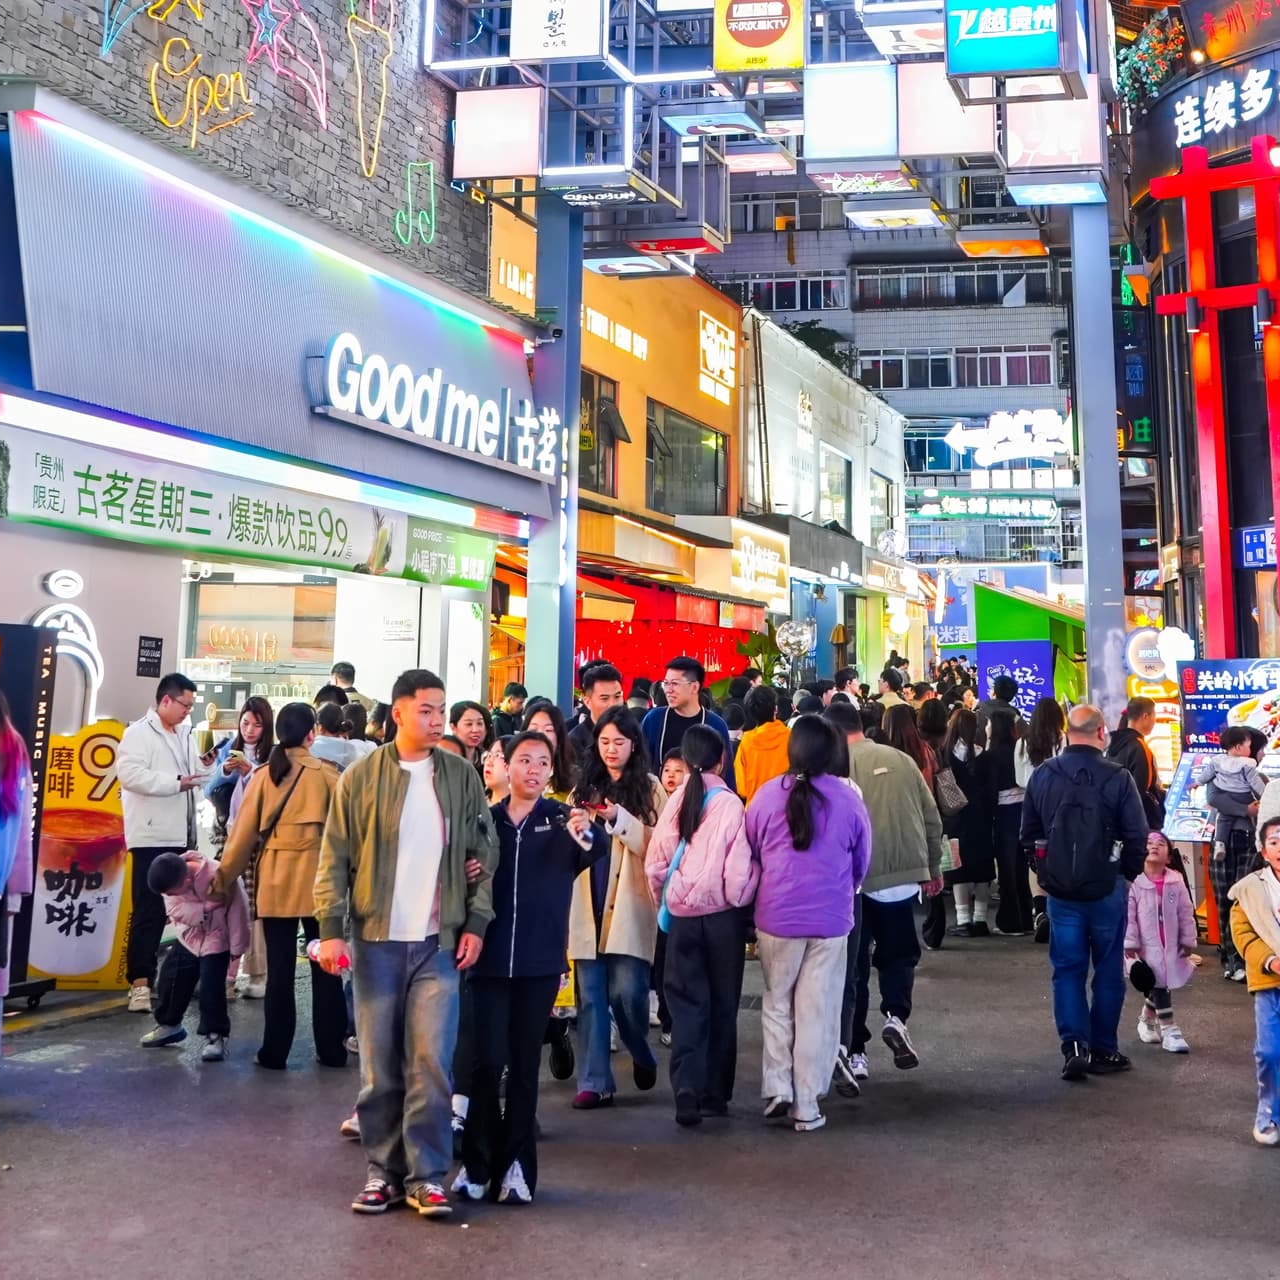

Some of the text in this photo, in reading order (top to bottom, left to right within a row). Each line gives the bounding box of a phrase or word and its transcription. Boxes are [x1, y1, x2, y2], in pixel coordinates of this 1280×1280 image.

[150, 37, 254, 149] Open
[328, 332, 500, 457] Good me
[514, 399, 561, 471] 古茗
[411, 548, 457, 578] 小程序下单
[39, 645, 53, 680] TEA
[32, 700, 48, 760] MUSIC
[43, 861, 103, 938] 咖啡
